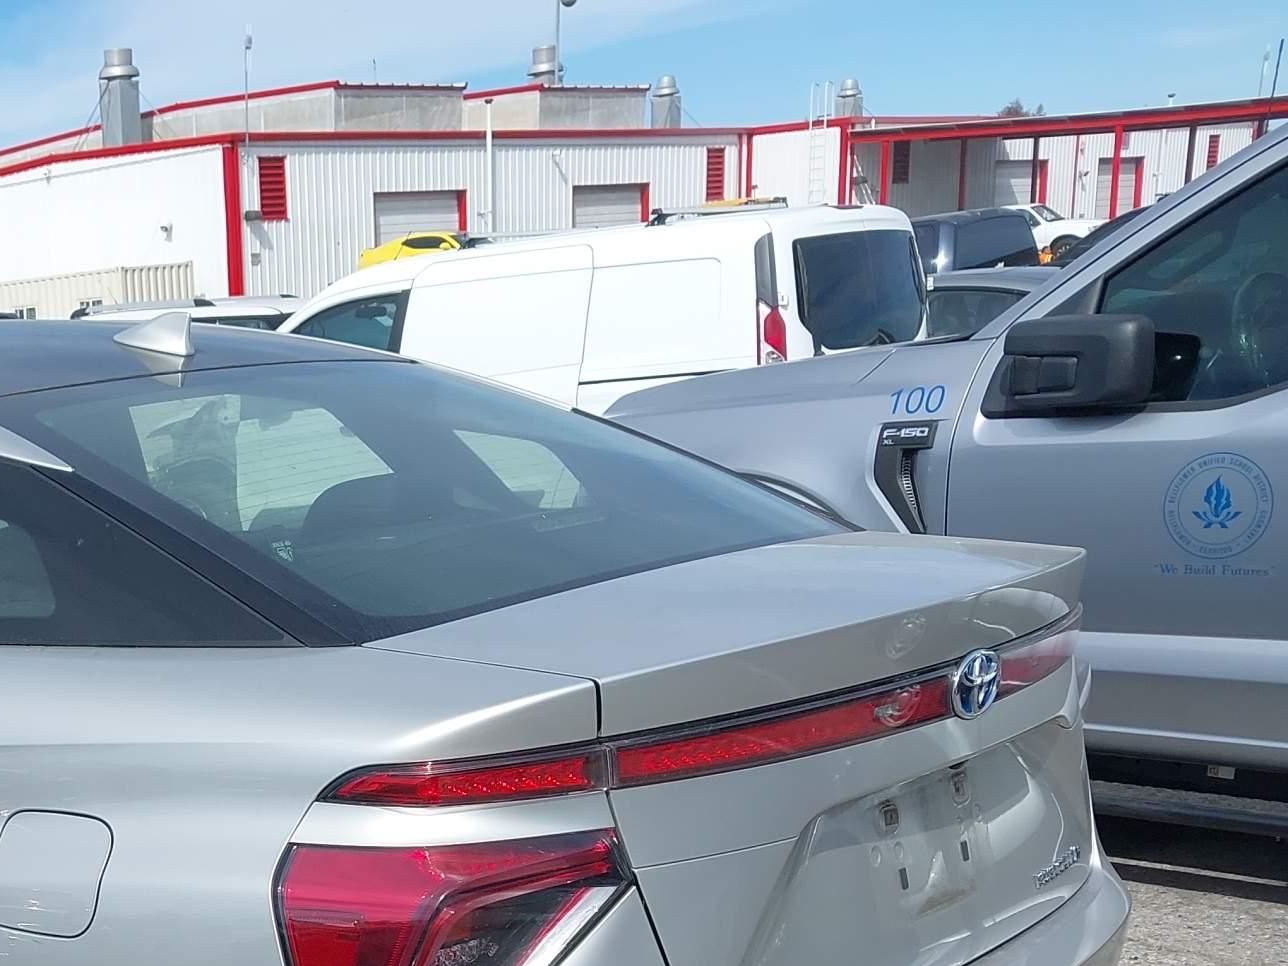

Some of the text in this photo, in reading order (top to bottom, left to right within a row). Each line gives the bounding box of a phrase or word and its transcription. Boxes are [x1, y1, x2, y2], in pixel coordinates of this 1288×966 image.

[890, 385, 946, 415] 100
[882, 427, 929, 438] F-150
[1184, 563, 1216, 577] Build
